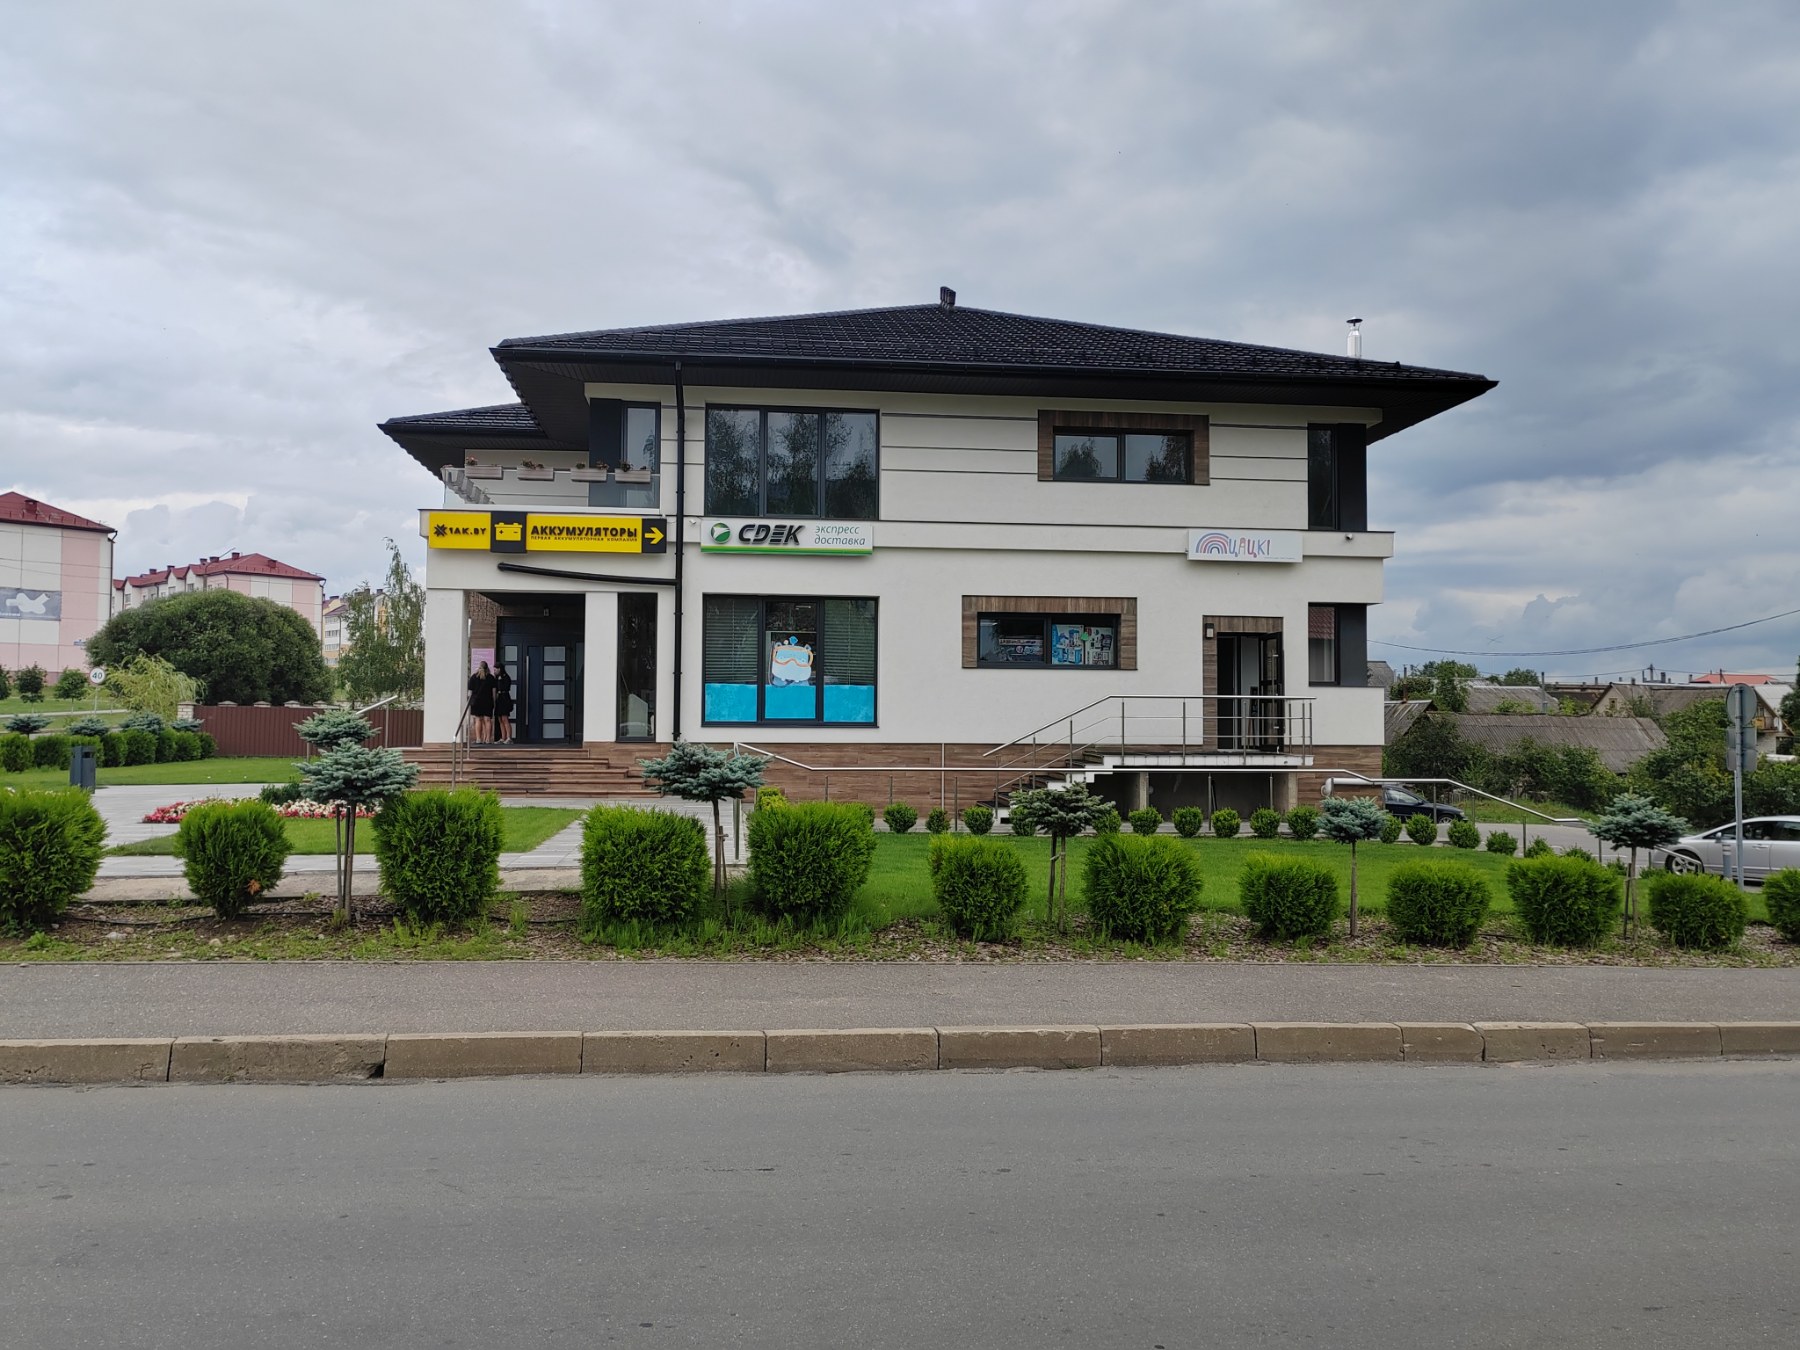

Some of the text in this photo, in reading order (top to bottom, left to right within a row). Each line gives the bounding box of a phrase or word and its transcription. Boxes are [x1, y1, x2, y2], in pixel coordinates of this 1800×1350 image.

[531, 525, 638, 538] АККУМУЛЯТОРЫ
[738, 524, 806, 545] CDEK
[815, 525, 860, 535] экспресс
[814, 535, 866, 546] доставка
[91, 672, 103, 680] 40
